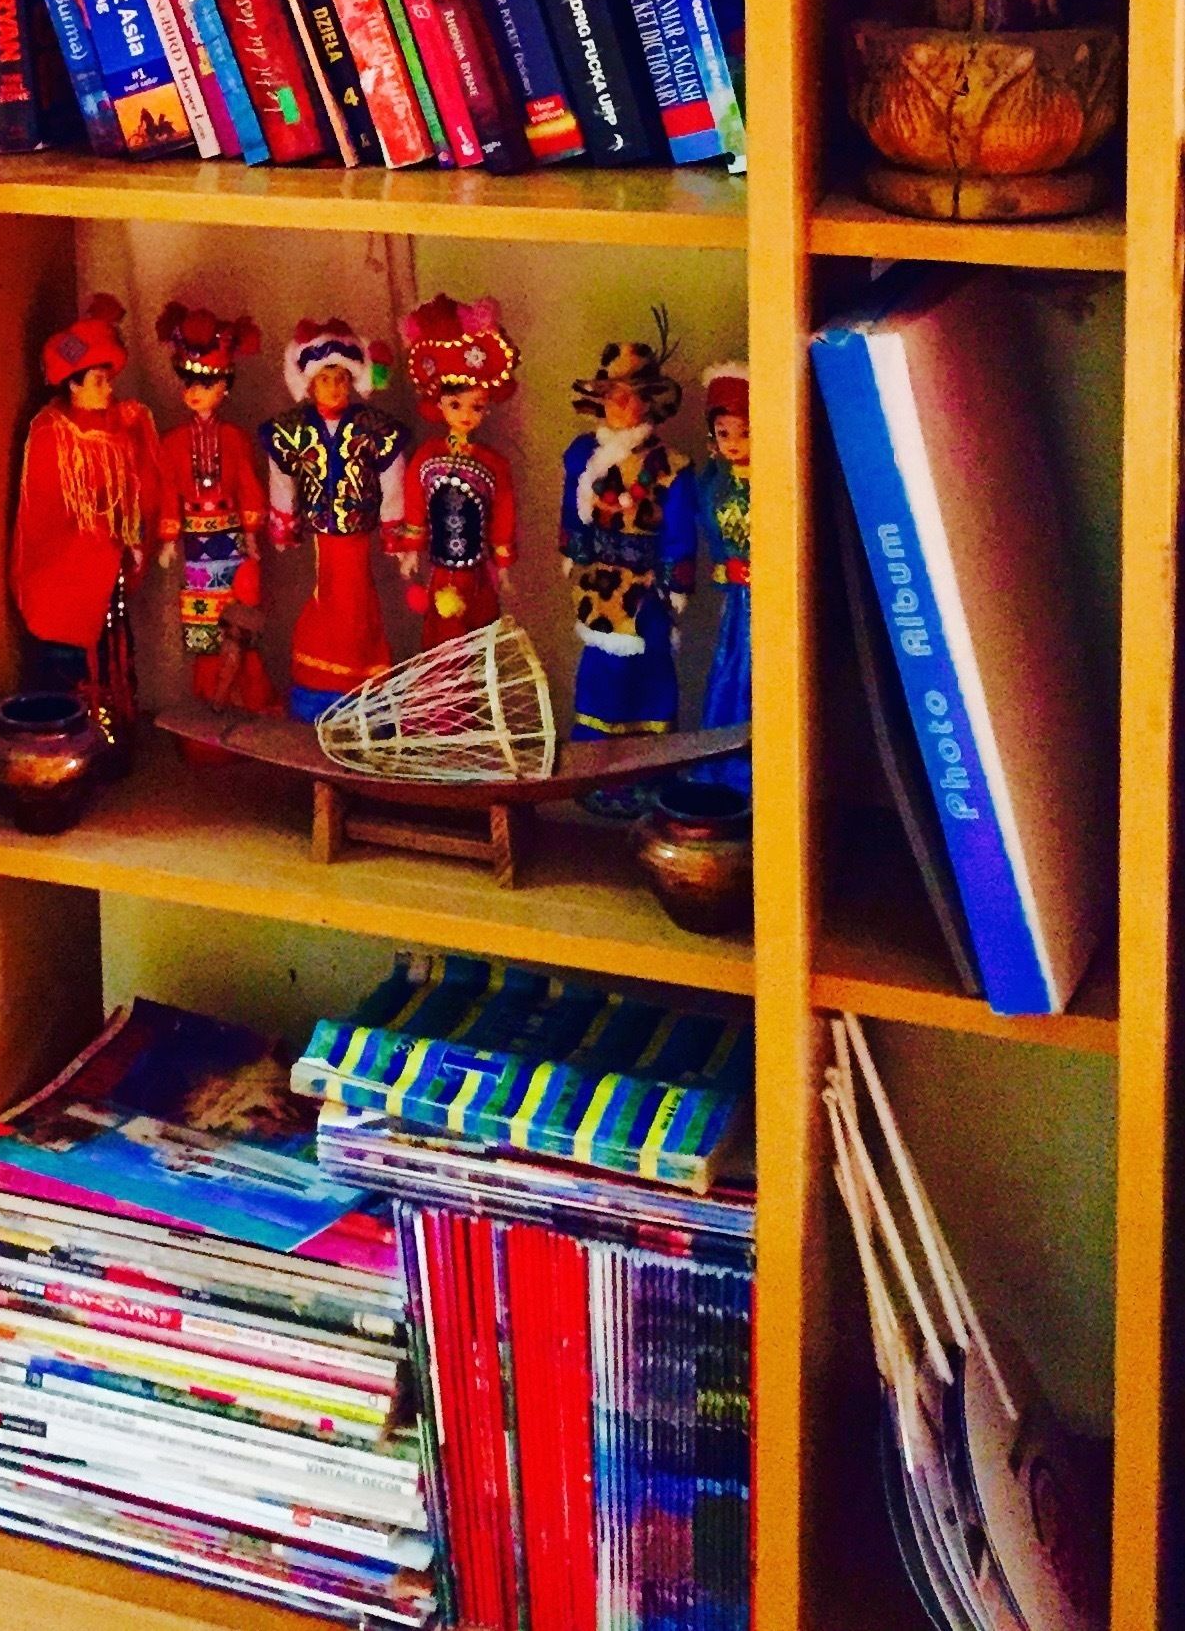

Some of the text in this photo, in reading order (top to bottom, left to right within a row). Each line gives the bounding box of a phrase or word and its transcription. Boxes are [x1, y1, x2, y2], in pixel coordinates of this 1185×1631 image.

[115, 4, 149, 58] Asia
[241, 33, 269, 63] du
[442, 8, 468, 61] RHONDA
[458, 59, 480, 98] BYRNE
[497, 6, 523, 50] POCKET
[339, 85, 361, 110] 4
[577, 37, 611, 94] FUCKA
[595, 92, 620, 128] UPP
[636, 27, 682, 109] DICTIONARY
[666, 43, 705, 104] ENGLISH
[875, 522, 980, 820] Photo Album
